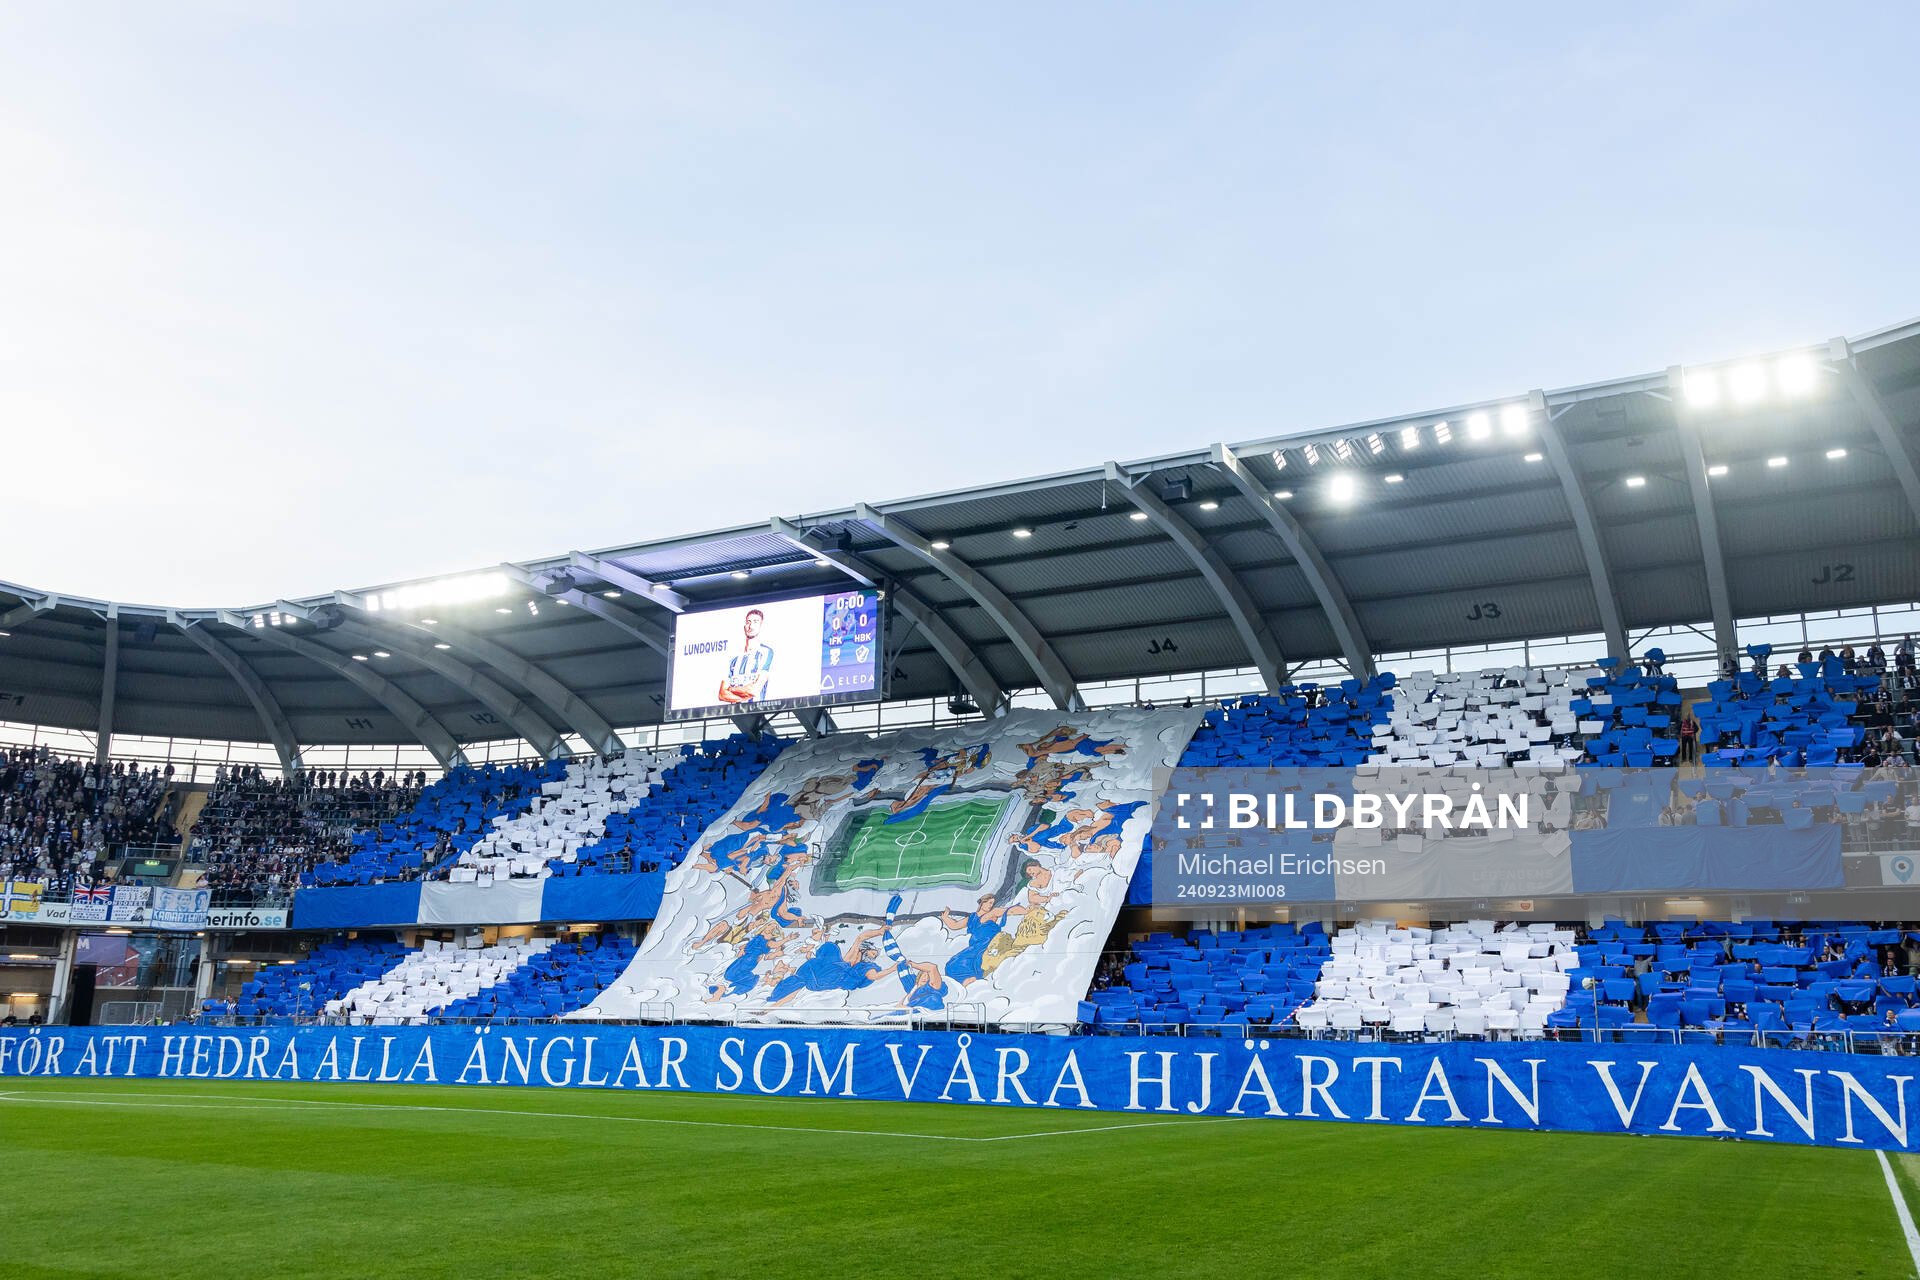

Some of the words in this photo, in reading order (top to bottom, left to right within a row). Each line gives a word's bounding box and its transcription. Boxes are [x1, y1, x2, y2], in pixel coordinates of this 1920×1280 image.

[1811, 564, 1855, 584] J2
[836, 594, 865, 610] 0:00
[1466, 603, 1501, 620] J3
[832, 617, 841, 631] 0
[859, 613, 868, 627] 0
[829, 636, 843, 646] IFK
[854, 632, 872, 643] HBK
[1147, 638, 1178, 654] J4
[684, 639, 729, 656] LUNDQVIST
[838, 674, 875, 686] ELEDA
[345, 718, 375, 729] H1
[469, 712, 500, 726] H2
[46, 909, 67, 918] Vad
[0, 1028, 64, 1076] FÖR
[73, 1036, 147, 1076] ATT
[158, 1036, 300, 1079] HEDRA
[312, 1035, 439, 1082] ALLA
[455, 1026, 691, 1088] ÄNGLAR
[715, 1037, 860, 1097] SOM
[885, 1033, 1097, 1108] VÅRA
[1123, 1039, 1546, 1126] HJÄRTAN
[1586, 1060, 1914, 1148] VANN
